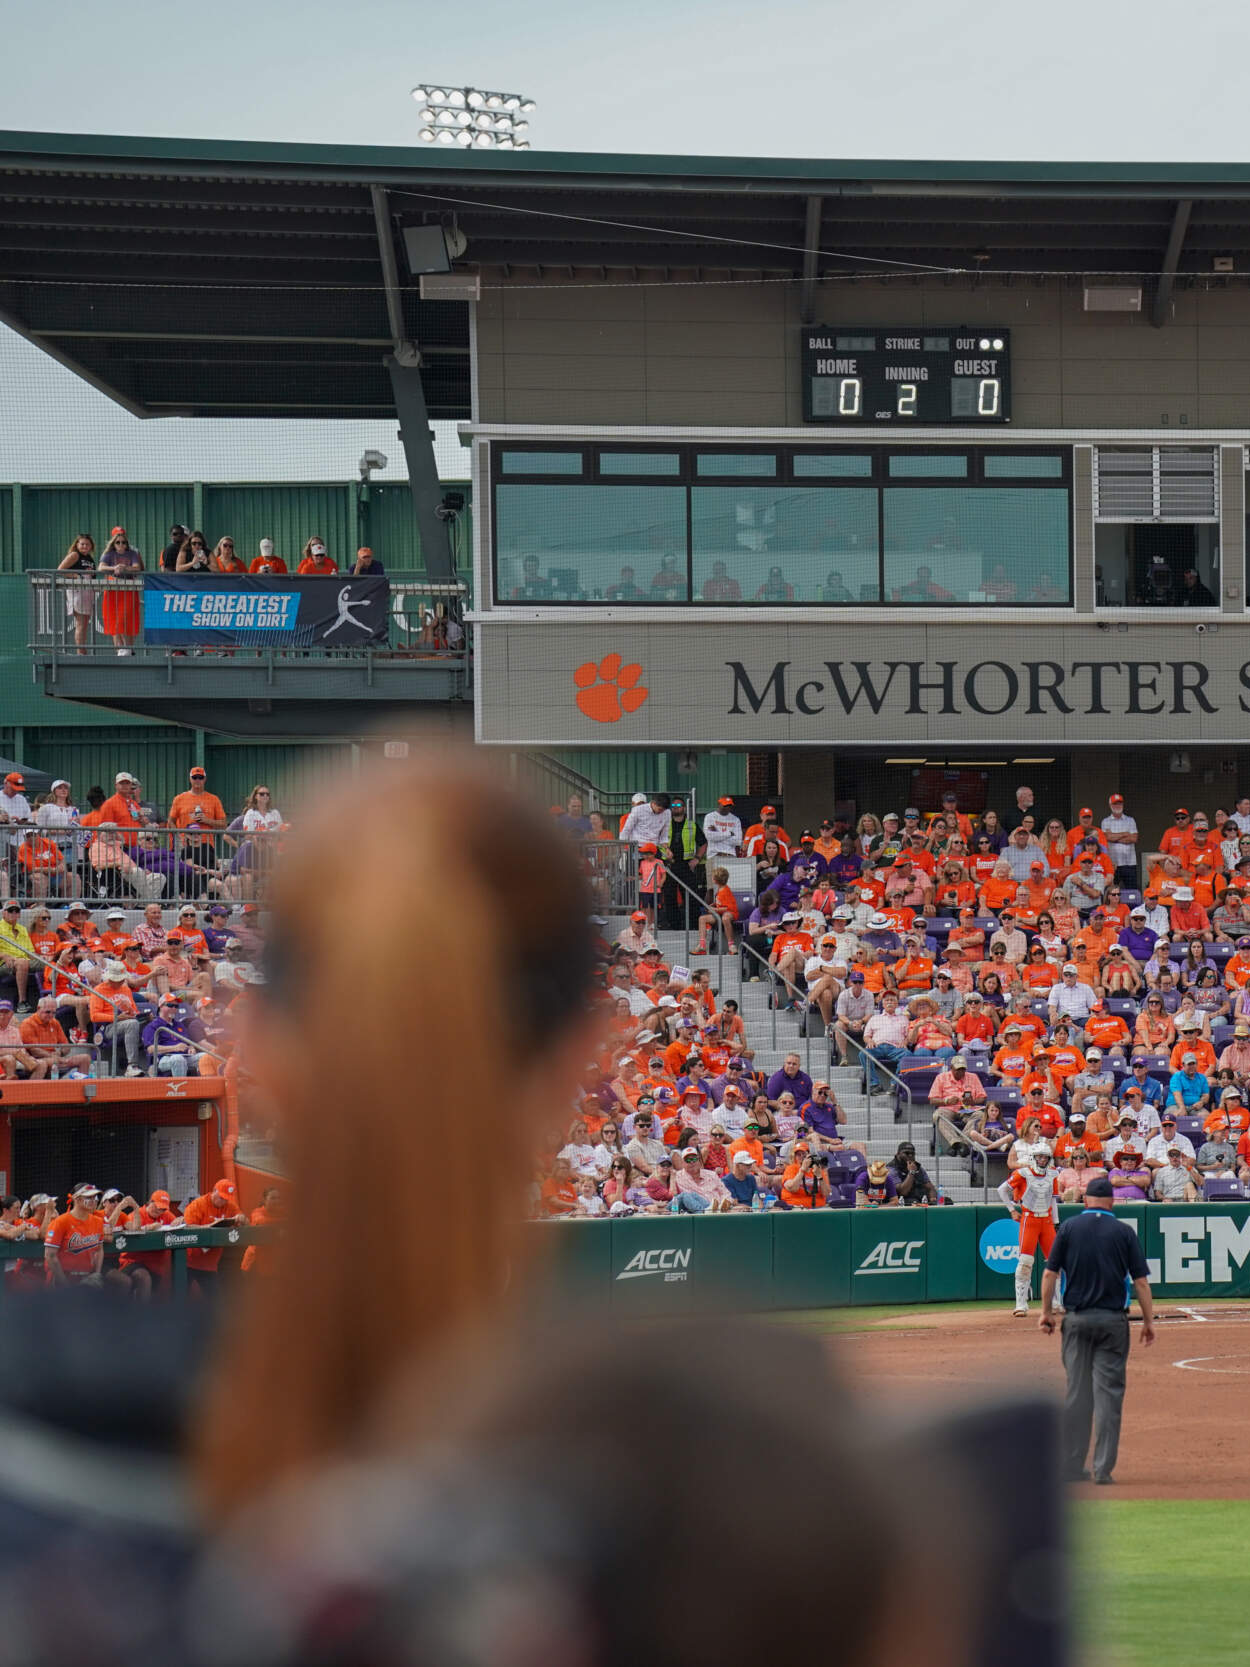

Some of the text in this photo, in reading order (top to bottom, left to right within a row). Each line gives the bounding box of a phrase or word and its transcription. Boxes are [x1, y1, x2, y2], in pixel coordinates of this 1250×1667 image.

[809, 338, 833, 349] BALL
[885, 338, 921, 349] STRIKE
[956, 338, 976, 349] OUT
[816, 359, 857, 375] HOME
[885, 367, 929, 381] INNING
[954, 359, 998, 375] GUEST
[839, 379, 860, 415] 0
[898, 384, 917, 415] 2
[978, 379, 999, 415] 0
[163, 594, 291, 613] THE GREATEST
[191, 613, 288, 627] SHOW ON DIRT
[725, 661, 1220, 716] McWHORTER
[624, 1249, 691, 1270] ACCN
[860, 1241, 925, 1268] ACC
[985, 1245, 1020, 1260] NCA
[664, 1272, 688, 1282] ESPN
